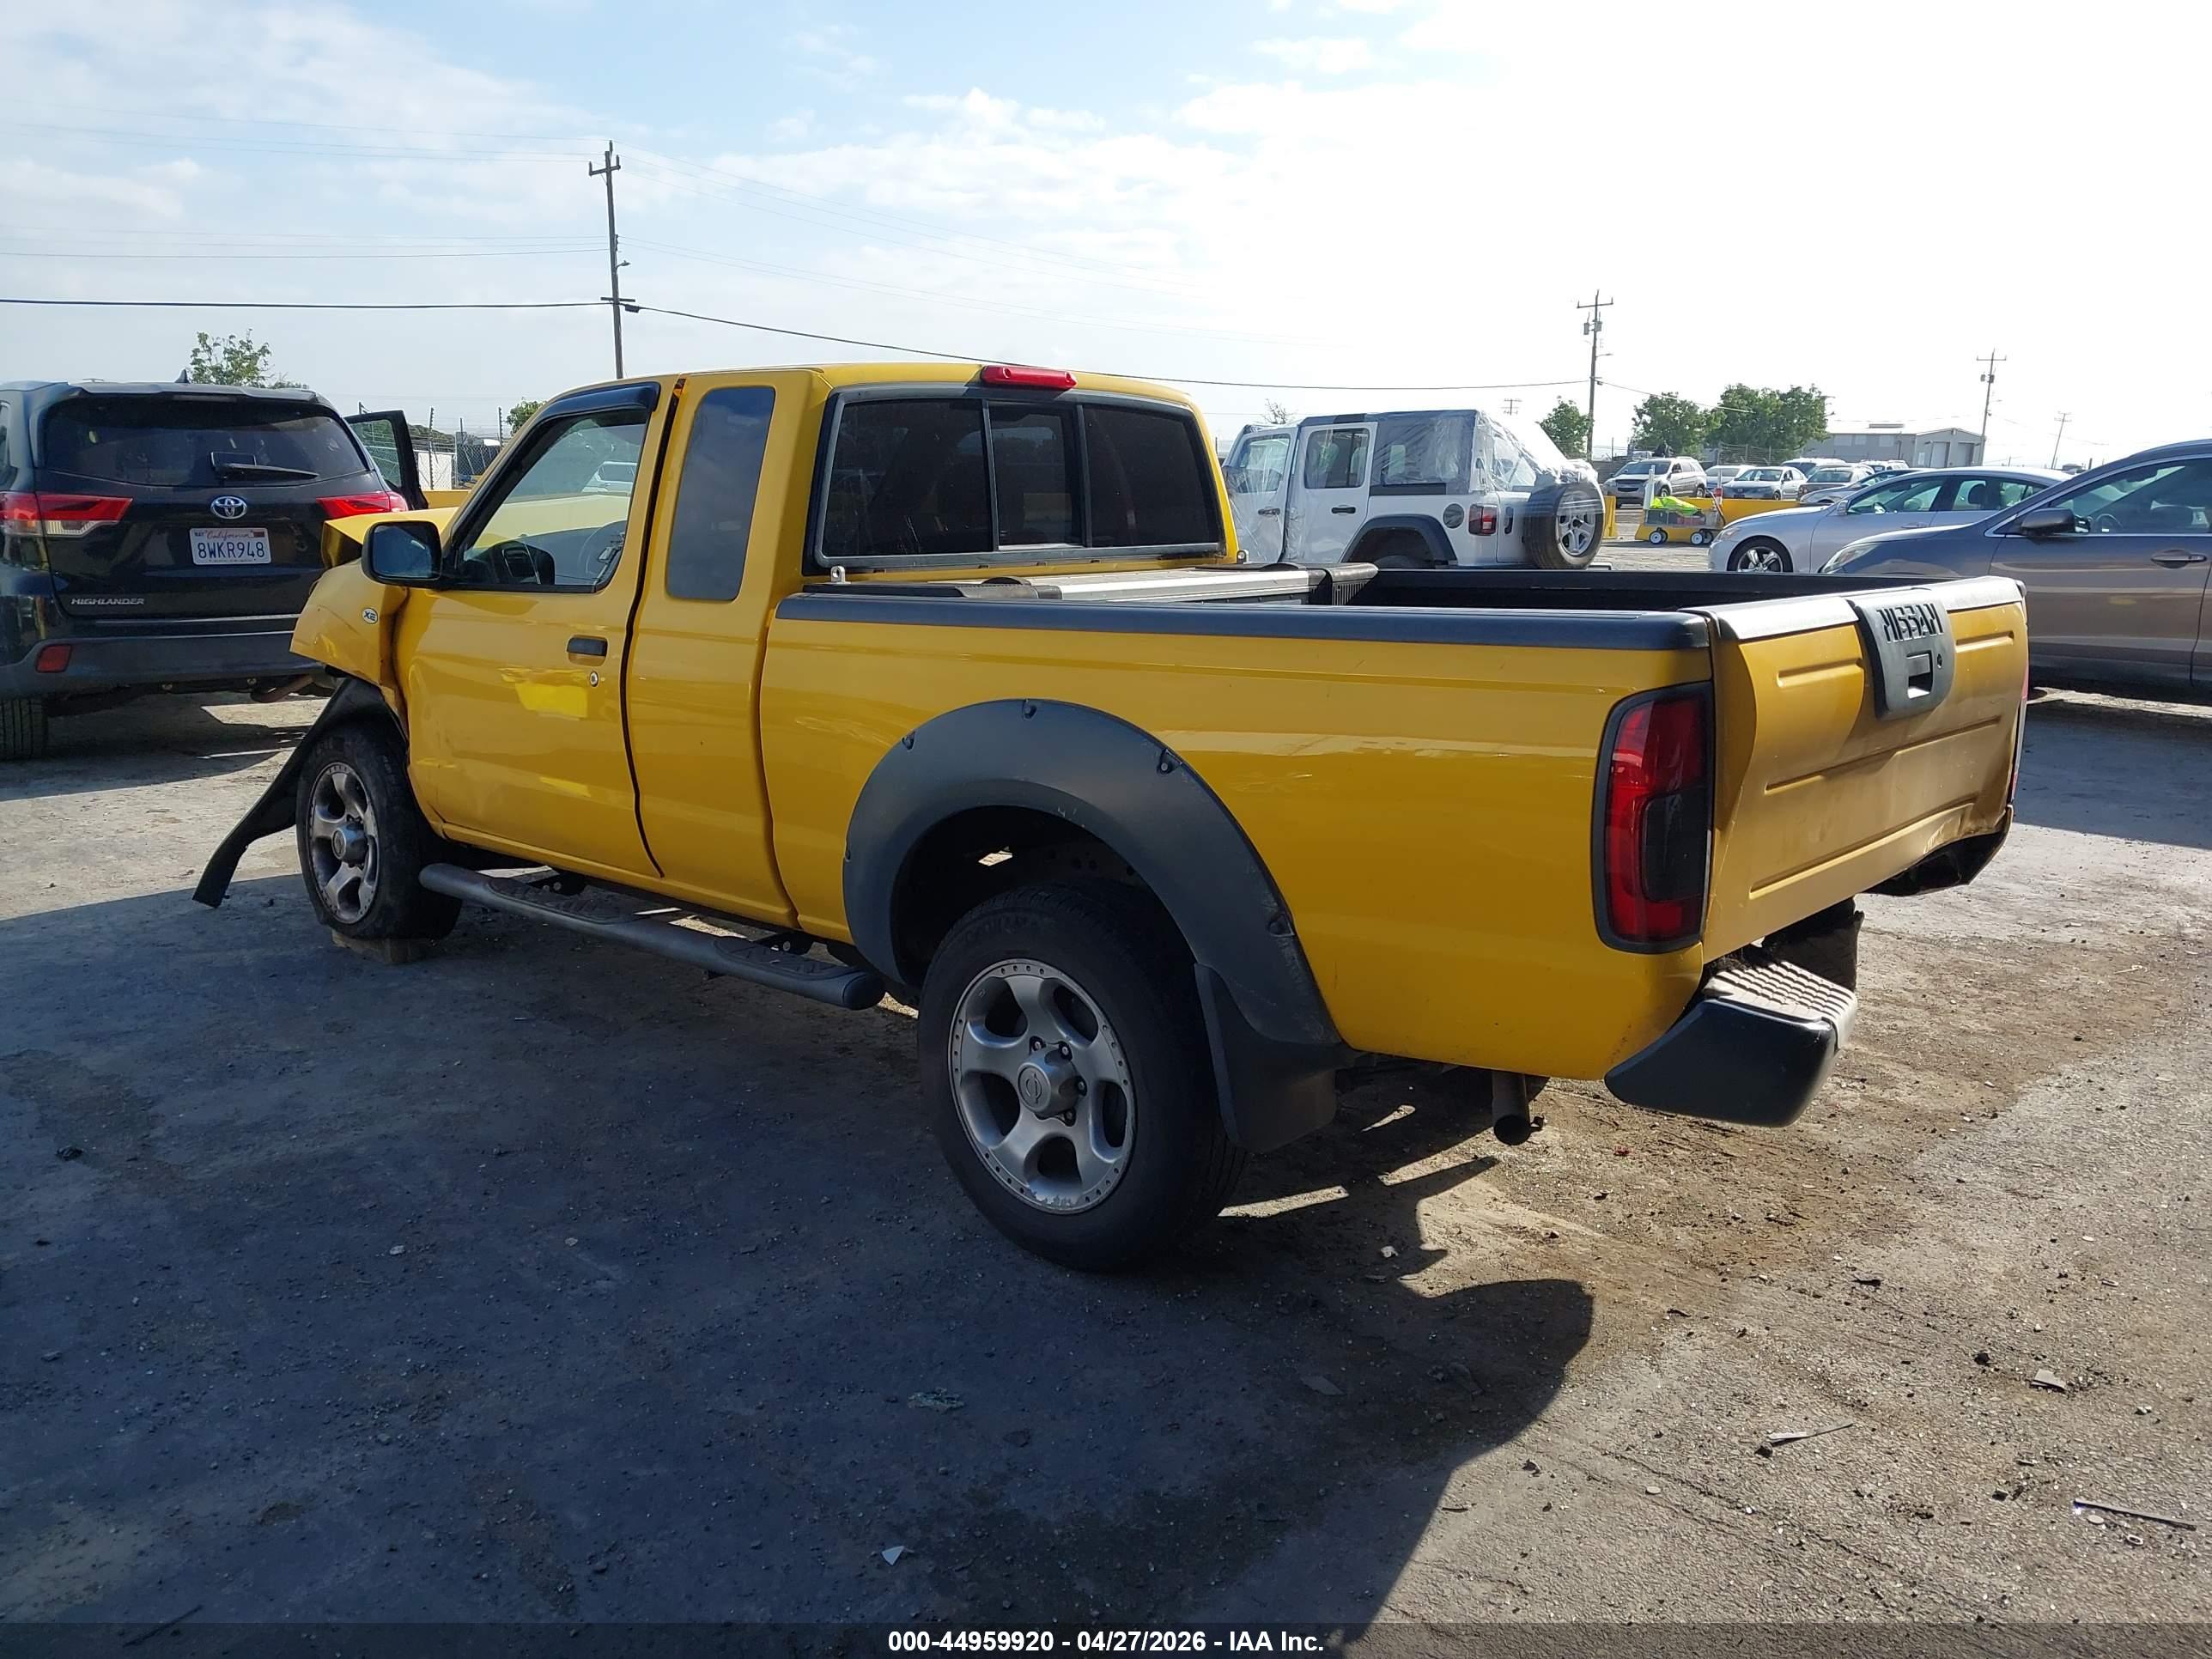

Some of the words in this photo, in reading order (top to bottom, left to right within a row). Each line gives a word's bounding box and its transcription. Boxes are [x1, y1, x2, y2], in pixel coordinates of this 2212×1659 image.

[207, 530, 251, 541] California
[198, 541, 265, 559] 8WKR948
[1876, 603, 1944, 643] NISSAN
